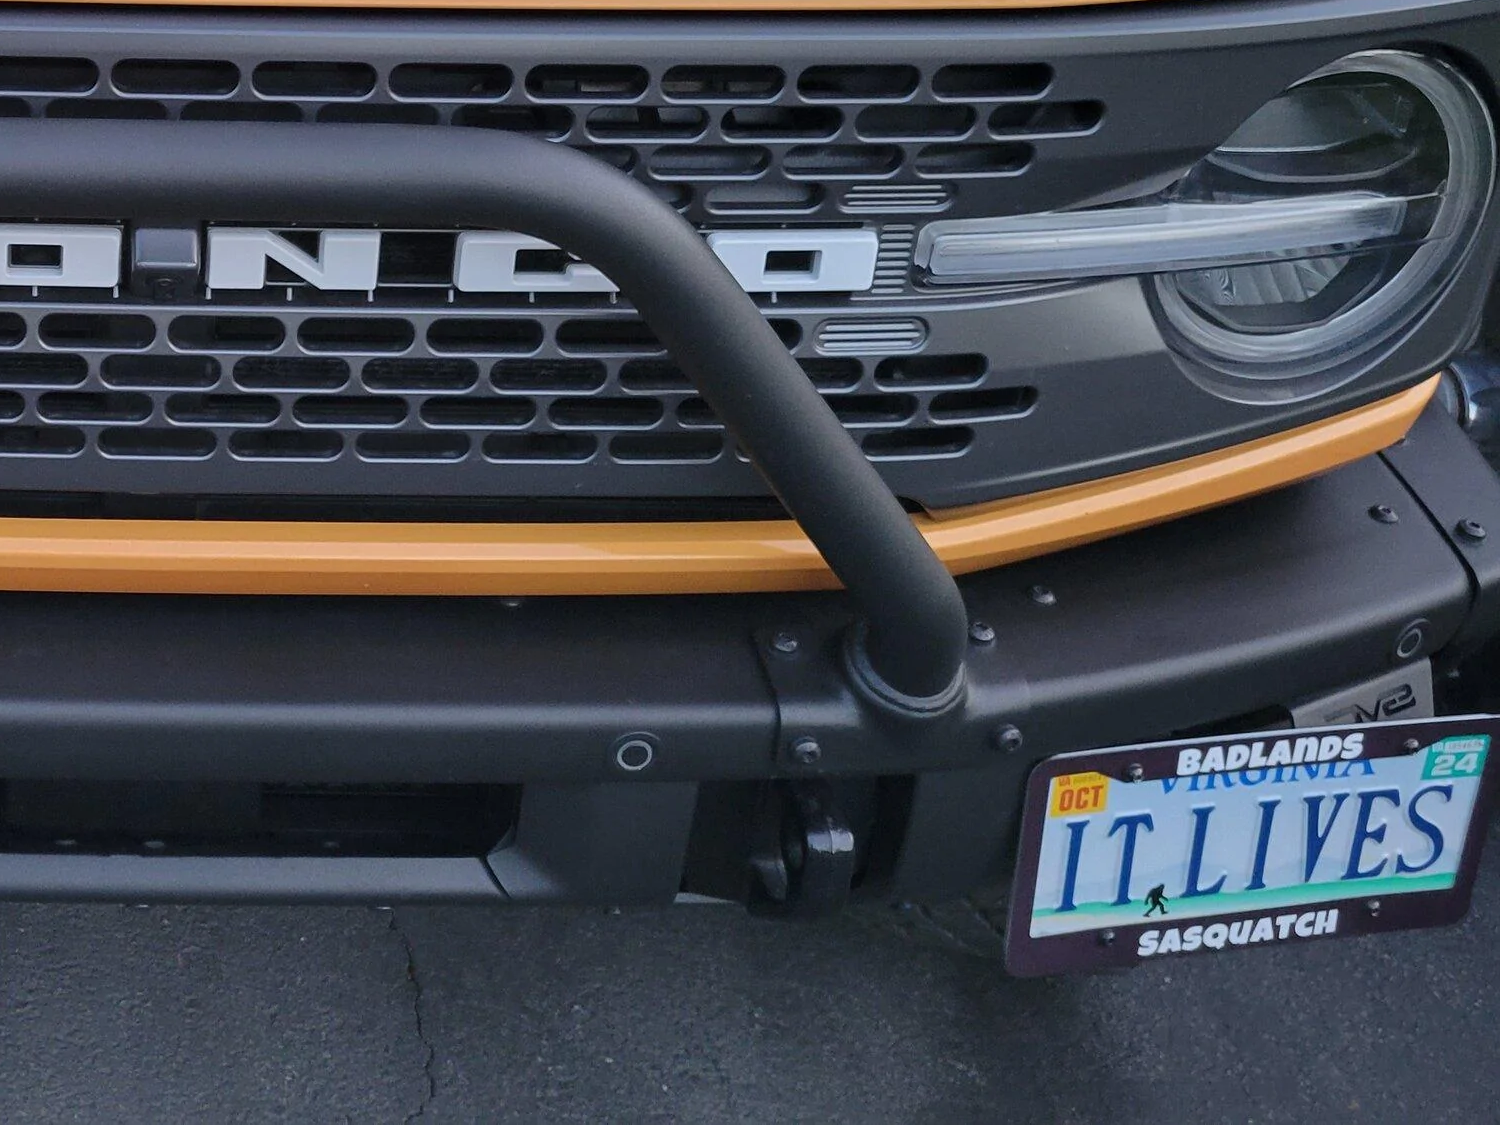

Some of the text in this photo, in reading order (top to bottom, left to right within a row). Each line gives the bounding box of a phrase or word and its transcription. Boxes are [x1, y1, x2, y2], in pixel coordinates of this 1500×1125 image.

[1176, 733, 1364, 776] BADLANDS
[1431, 753, 1478, 776] 24
[1059, 785, 1104, 811] OCT
[1057, 785, 1453, 912] IT LIVES
[1137, 909, 1339, 957] SASQUATCH
